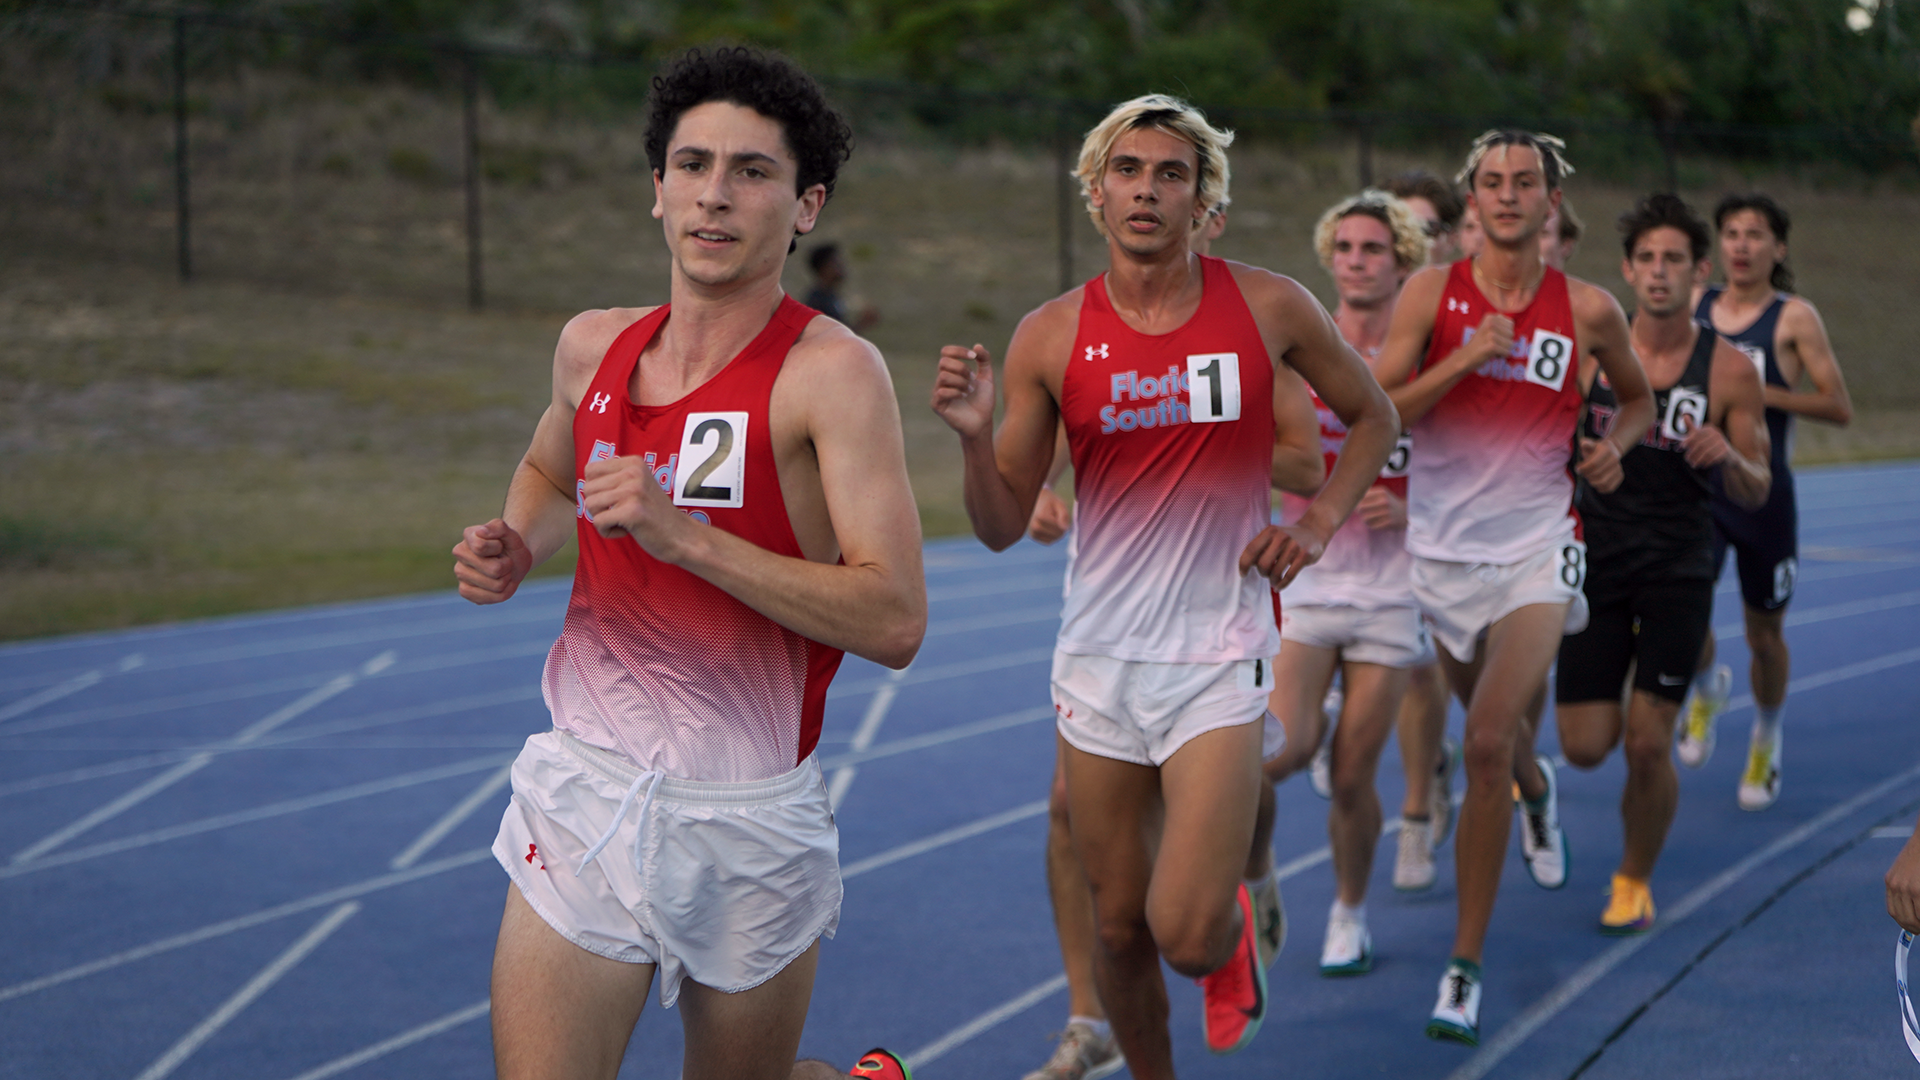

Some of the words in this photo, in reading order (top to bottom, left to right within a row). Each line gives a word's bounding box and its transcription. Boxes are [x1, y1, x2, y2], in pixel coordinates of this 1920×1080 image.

[1534, 338, 1565, 382] 8
[1111, 364, 1190, 404] Flori
[1196, 358, 1224, 418] 1
[1099, 397, 1191, 435] South
[1671, 397, 1698, 435] 6
[681, 418, 734, 501] 2
[1561, 546, 1580, 588] 8
